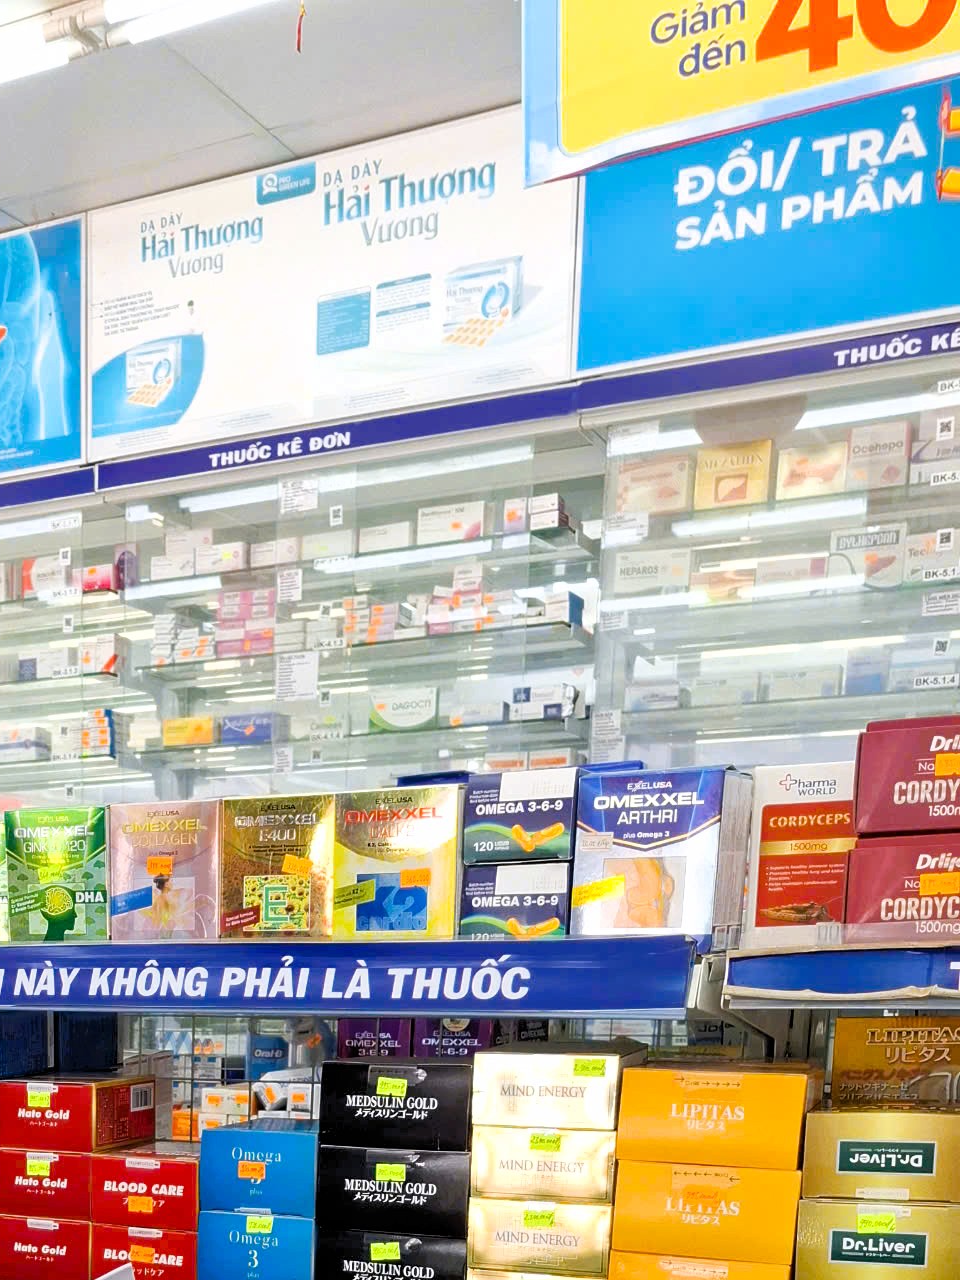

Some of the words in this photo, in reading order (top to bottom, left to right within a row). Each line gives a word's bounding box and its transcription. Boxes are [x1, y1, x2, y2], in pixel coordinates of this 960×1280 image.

[650, 0, 746, 44] Giảm
[679, 36, 746, 77] đến
[675, 138, 801, 206] ĐỔI/
[813, 106, 927, 175] TRẢ
[323, 184, 370, 227] Hải
[379, 160, 496, 212] Thượng
[675, 203, 766, 250] SẢN
[782, 167, 924, 230] PHẨM
[361, 209, 439, 247] Vương
[141, 231, 175, 262] Hải
[181, 215, 263, 254] Thượng
[168, 250, 224, 279] Vương
[834, 334, 922, 366] THUỐC
[209, 440, 271, 467] THUỐC
[277, 437, 304, 457] KÊ
[309, 432, 351, 452] ĐƠN
[798, 787, 837, 796] WORLD
[476, 803, 524, 815] OMEGA
[528, 800, 564, 811] 3-6-9
[593, 793, 704, 810] OMEXXEL
[344, 807, 442, 824] OMEXXEL
[617, 809, 678, 825] ARTHRI
[769, 813, 851, 828] CORDYCEPS
[473, 841, 493, 852] 120
[790, 843, 828, 853] 1500mg
[75, 891, 104, 903] DHA
[472, 896, 520, 908] OMEGA
[523, 895, 558, 906] 3-6-9
[13, 960, 77, 996] NÀY
[87, 959, 208, 996] KHÔNG
[219, 955, 306, 998] PHẢI
[321, 959, 369, 999] LÀ
[386, 954, 530, 1000] THUỐC
[886, 1047, 951, 1063] リピタス
[18, 1108, 43, 1119] Hato
[45, 1109, 70, 1120] Gold
[355, 1108, 428, 1119] メディスリンゴールド
[15, 1176, 40, 1187] Hato
[42, 1177, 67, 1188] Gold
[104, 1181, 148, 1194] BLOOD
[151, 1184, 184, 1196] CARE
[229, 1229, 279, 1247] Omega
[495, 1230, 529, 1243] MIND
[532, 1233, 581, 1247] ENERGY
[842, 1237, 916, 1253] Dr.Liver
[343, 1260, 401, 1276] MEDSULIN
[403, 1265, 435, 1279] GOLD
